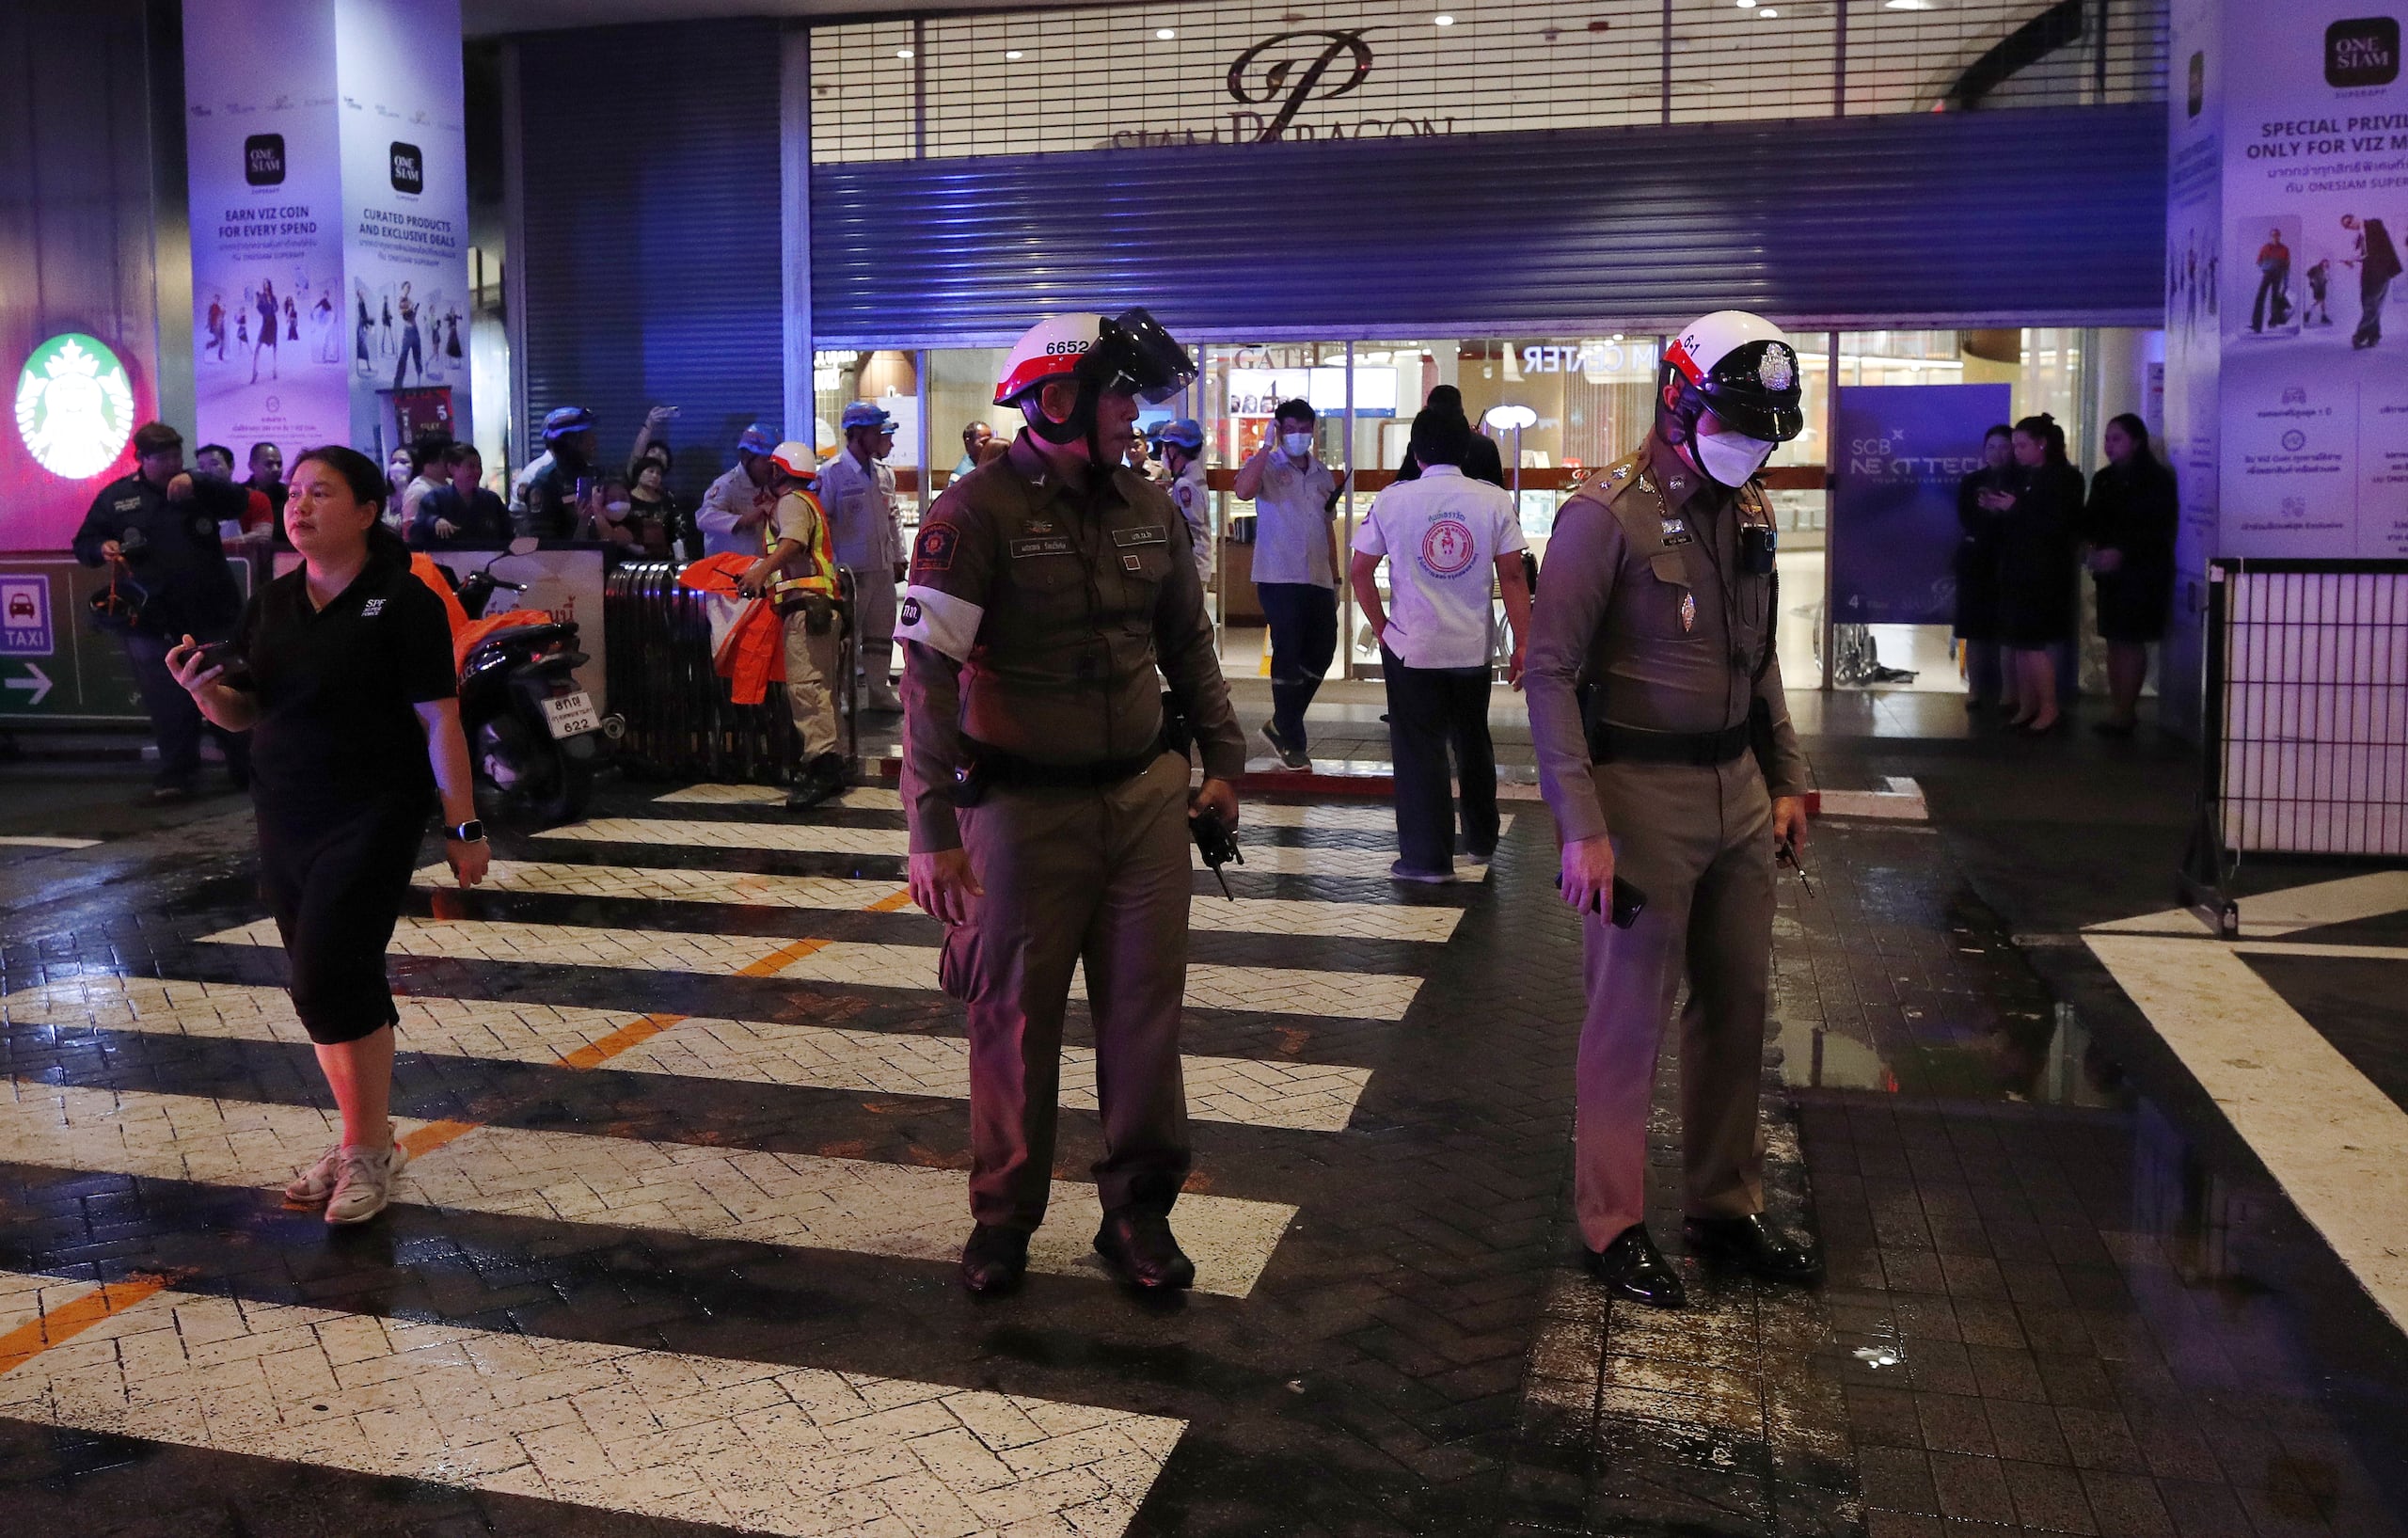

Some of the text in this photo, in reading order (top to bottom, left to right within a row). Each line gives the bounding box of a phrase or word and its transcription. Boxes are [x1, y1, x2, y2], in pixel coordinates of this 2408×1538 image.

[2336, 36, 2379, 54] ONE
[2337, 51, 2388, 70] SIAM
[2261, 119, 2341, 137] SPECIAL
[250, 149, 275, 161] ONE
[2246, 141, 2301, 159] ONLY
[2307, 139, 2346, 155] FOR
[2352, 136, 2384, 152] VIZ
[251, 159, 280, 173] SIAM
[394, 154, 414, 168] ONE
[395, 166, 419, 182] SIAM
[226, 205, 309, 222] EARN VIZ COIN
[363, 208, 452, 232] CURATED PRODUCTS
[218, 222, 317, 238] FOR EVERY SPEND
[359, 223, 455, 247] AND EXCLUSIVE DEALS
[1046, 341, 1089, 355] 6652
[365, 598, 388, 608] SPF
[5, 630, 44, 647] TAXI
[564, 719, 590, 733] 622
